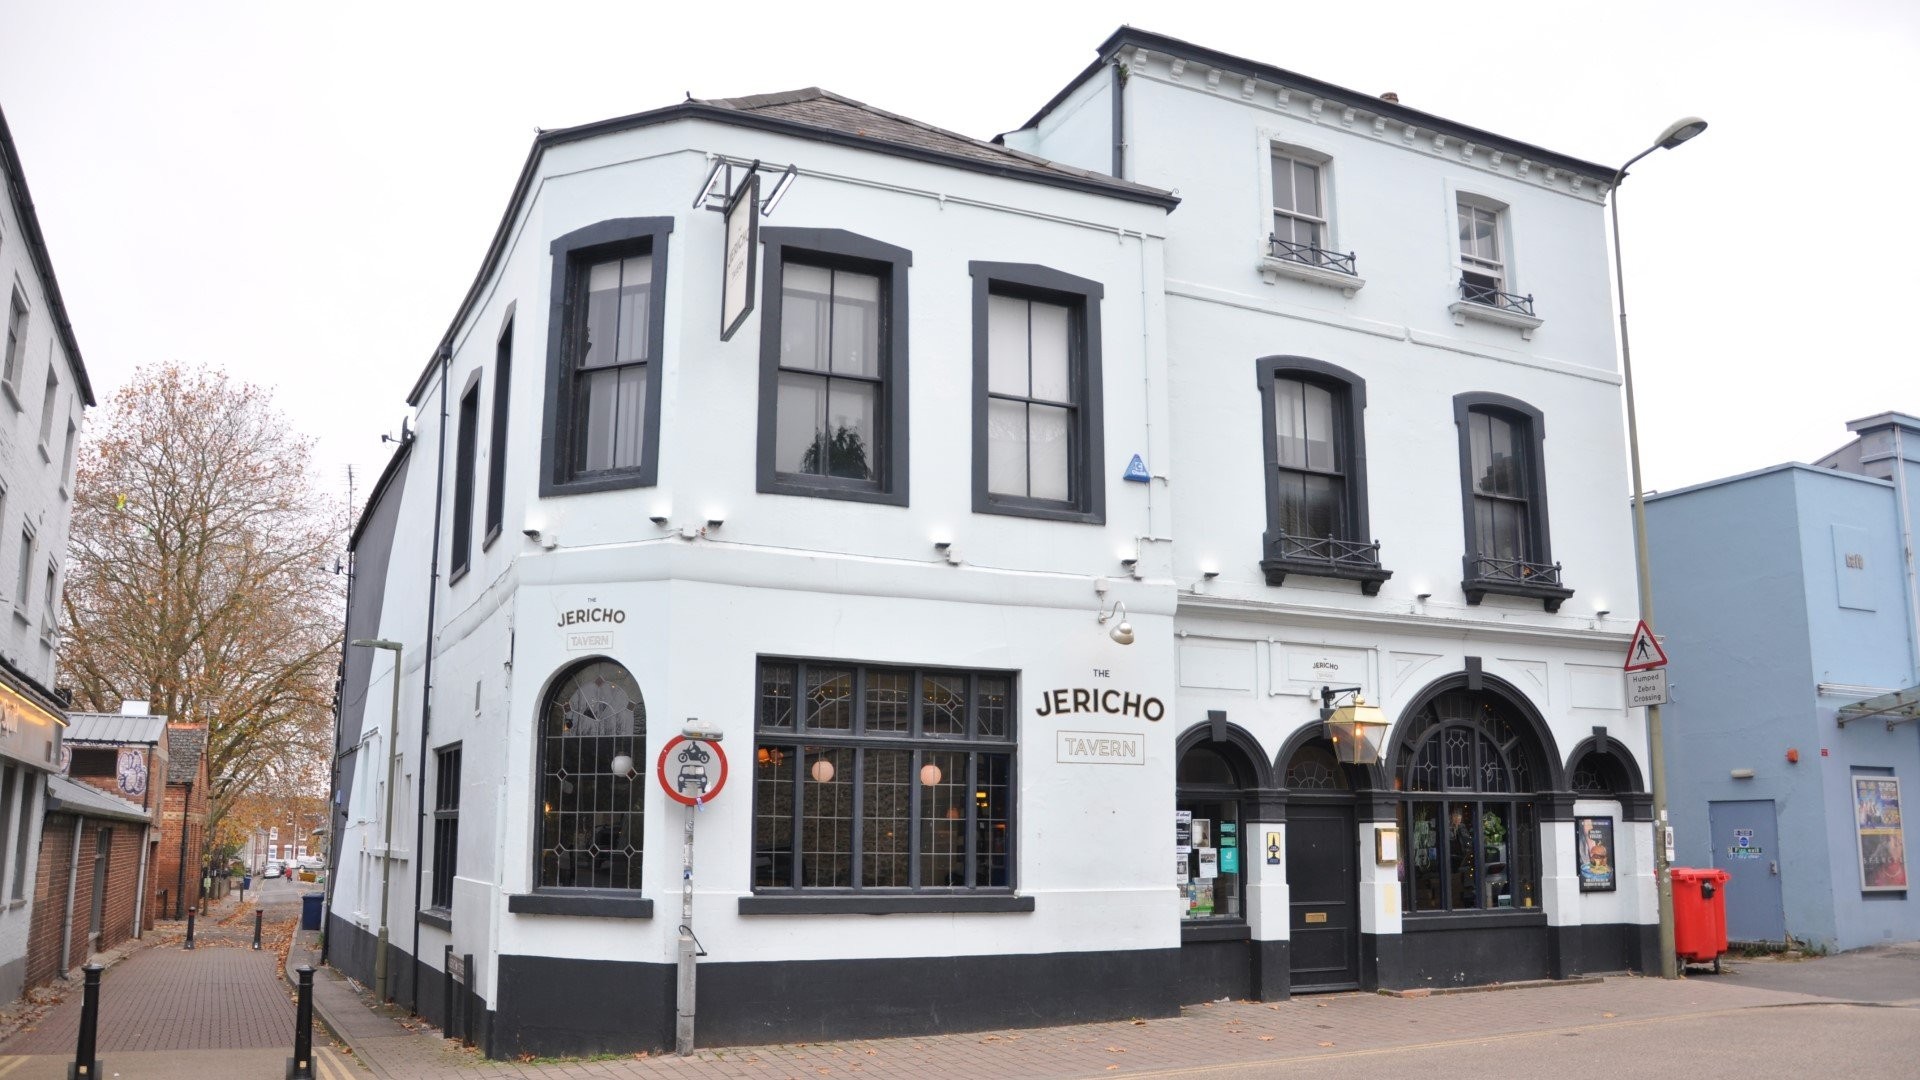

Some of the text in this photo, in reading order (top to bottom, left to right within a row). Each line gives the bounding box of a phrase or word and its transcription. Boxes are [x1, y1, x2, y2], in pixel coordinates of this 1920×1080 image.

[557, 607, 626, 628] JERICHO
[570, 635, 609, 647] TAVERN
[1312, 662, 1339, 671] JERICHO
[1093, 669, 1110, 678] THE
[1632, 673, 1660, 683] Humped
[1637, 685, 1656, 693] Zebra
[1633, 694, 1662, 702] Crossing
[1035, 688, 1165, 722] JERICHO
[1064, 737, 1136, 757] TAVERN
